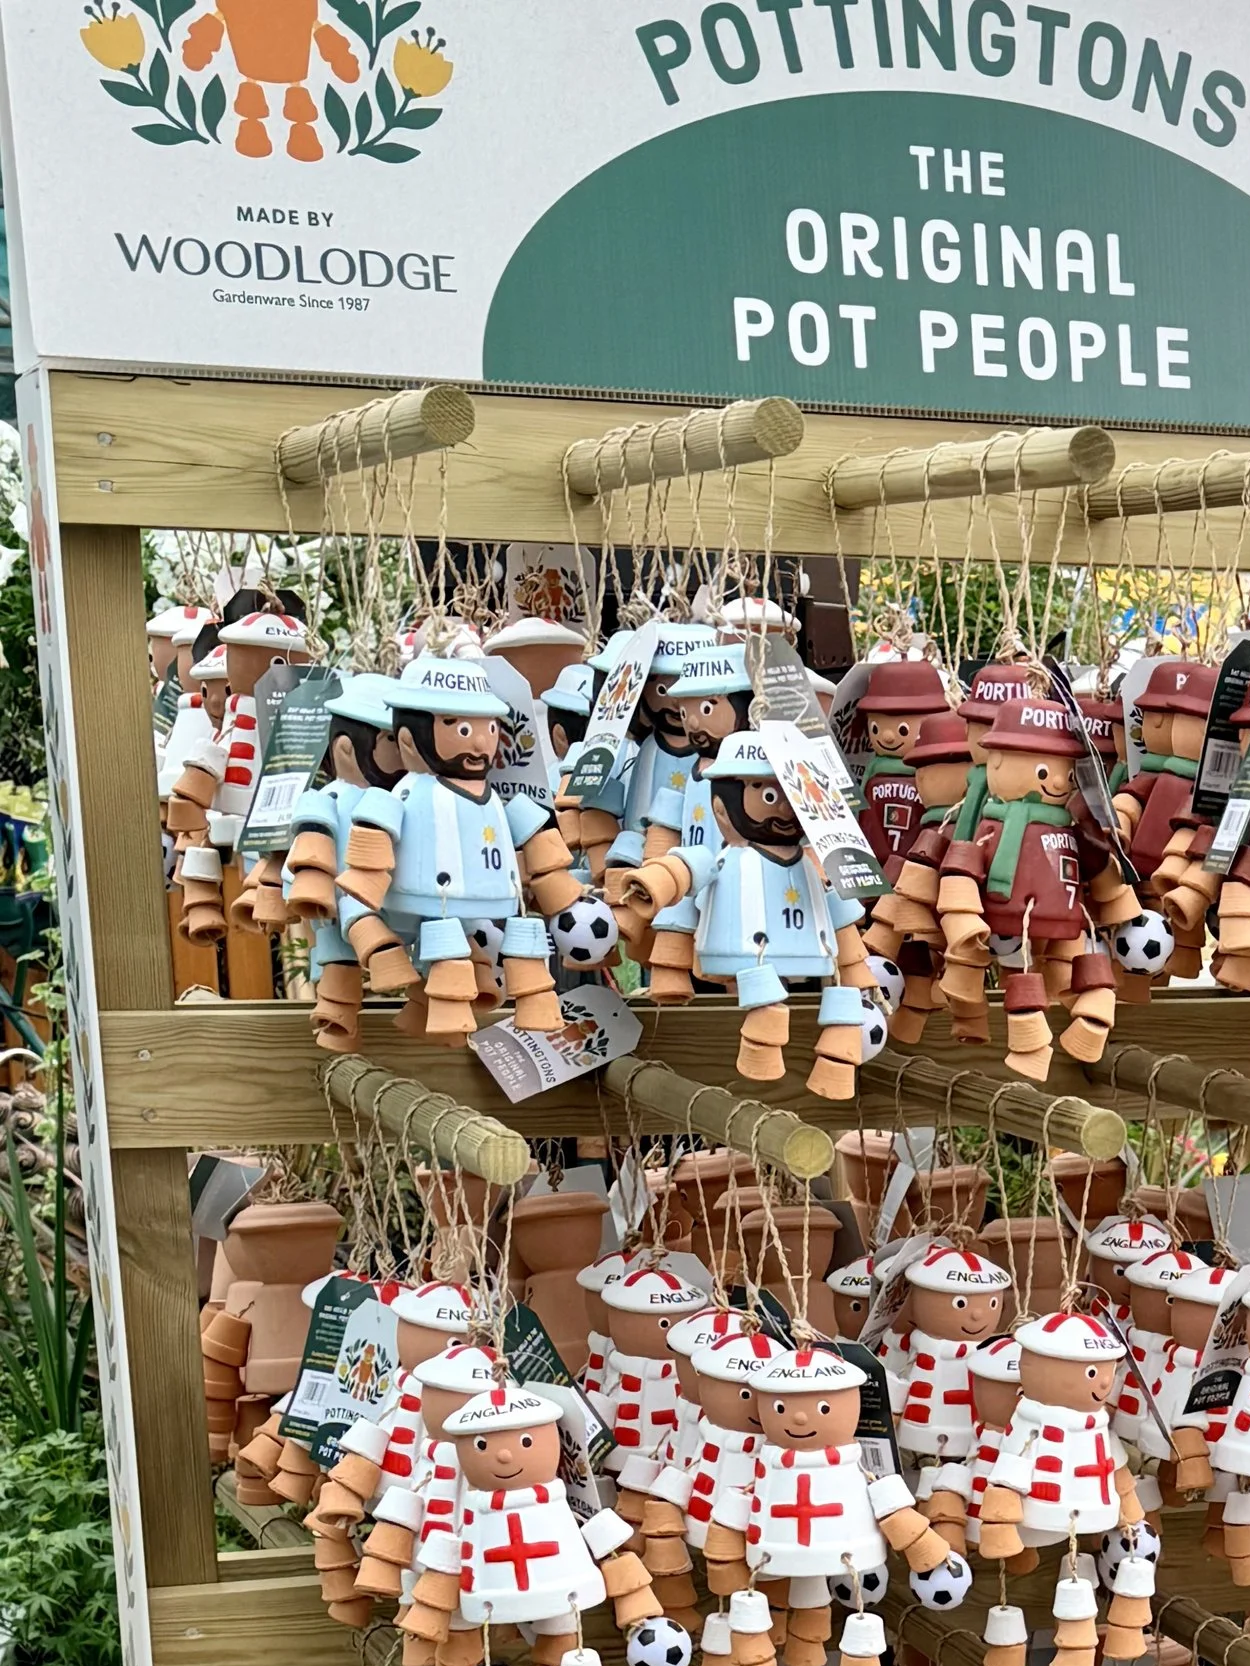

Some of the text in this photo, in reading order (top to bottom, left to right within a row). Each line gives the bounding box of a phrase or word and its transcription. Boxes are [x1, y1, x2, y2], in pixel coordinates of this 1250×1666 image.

[635, 0, 1246, 147] POTTINGTONS
[910, 144, 1005, 197] THE
[236, 205, 334, 228] MADE BY
[114, 232, 458, 293] WOODLODGE
[786, 207, 1135, 297] ORIGINAL
[212, 288, 370, 312] Gardenware Since 1987
[733, 297, 1192, 389] POT PEOPLE
[689, 825, 703, 845] 10
[888, 829, 900, 852] 7
[481, 847, 502, 870] 10
[1065, 885, 1076, 909] 7
[782, 908, 803, 930] 10
[494, 1042, 528, 1080] ORIGINAL
[767, 1364, 846, 1379] ENGLAND
[459, 1396, 541, 1425] ENGLAND
[318, 1446, 332, 1458] POT
